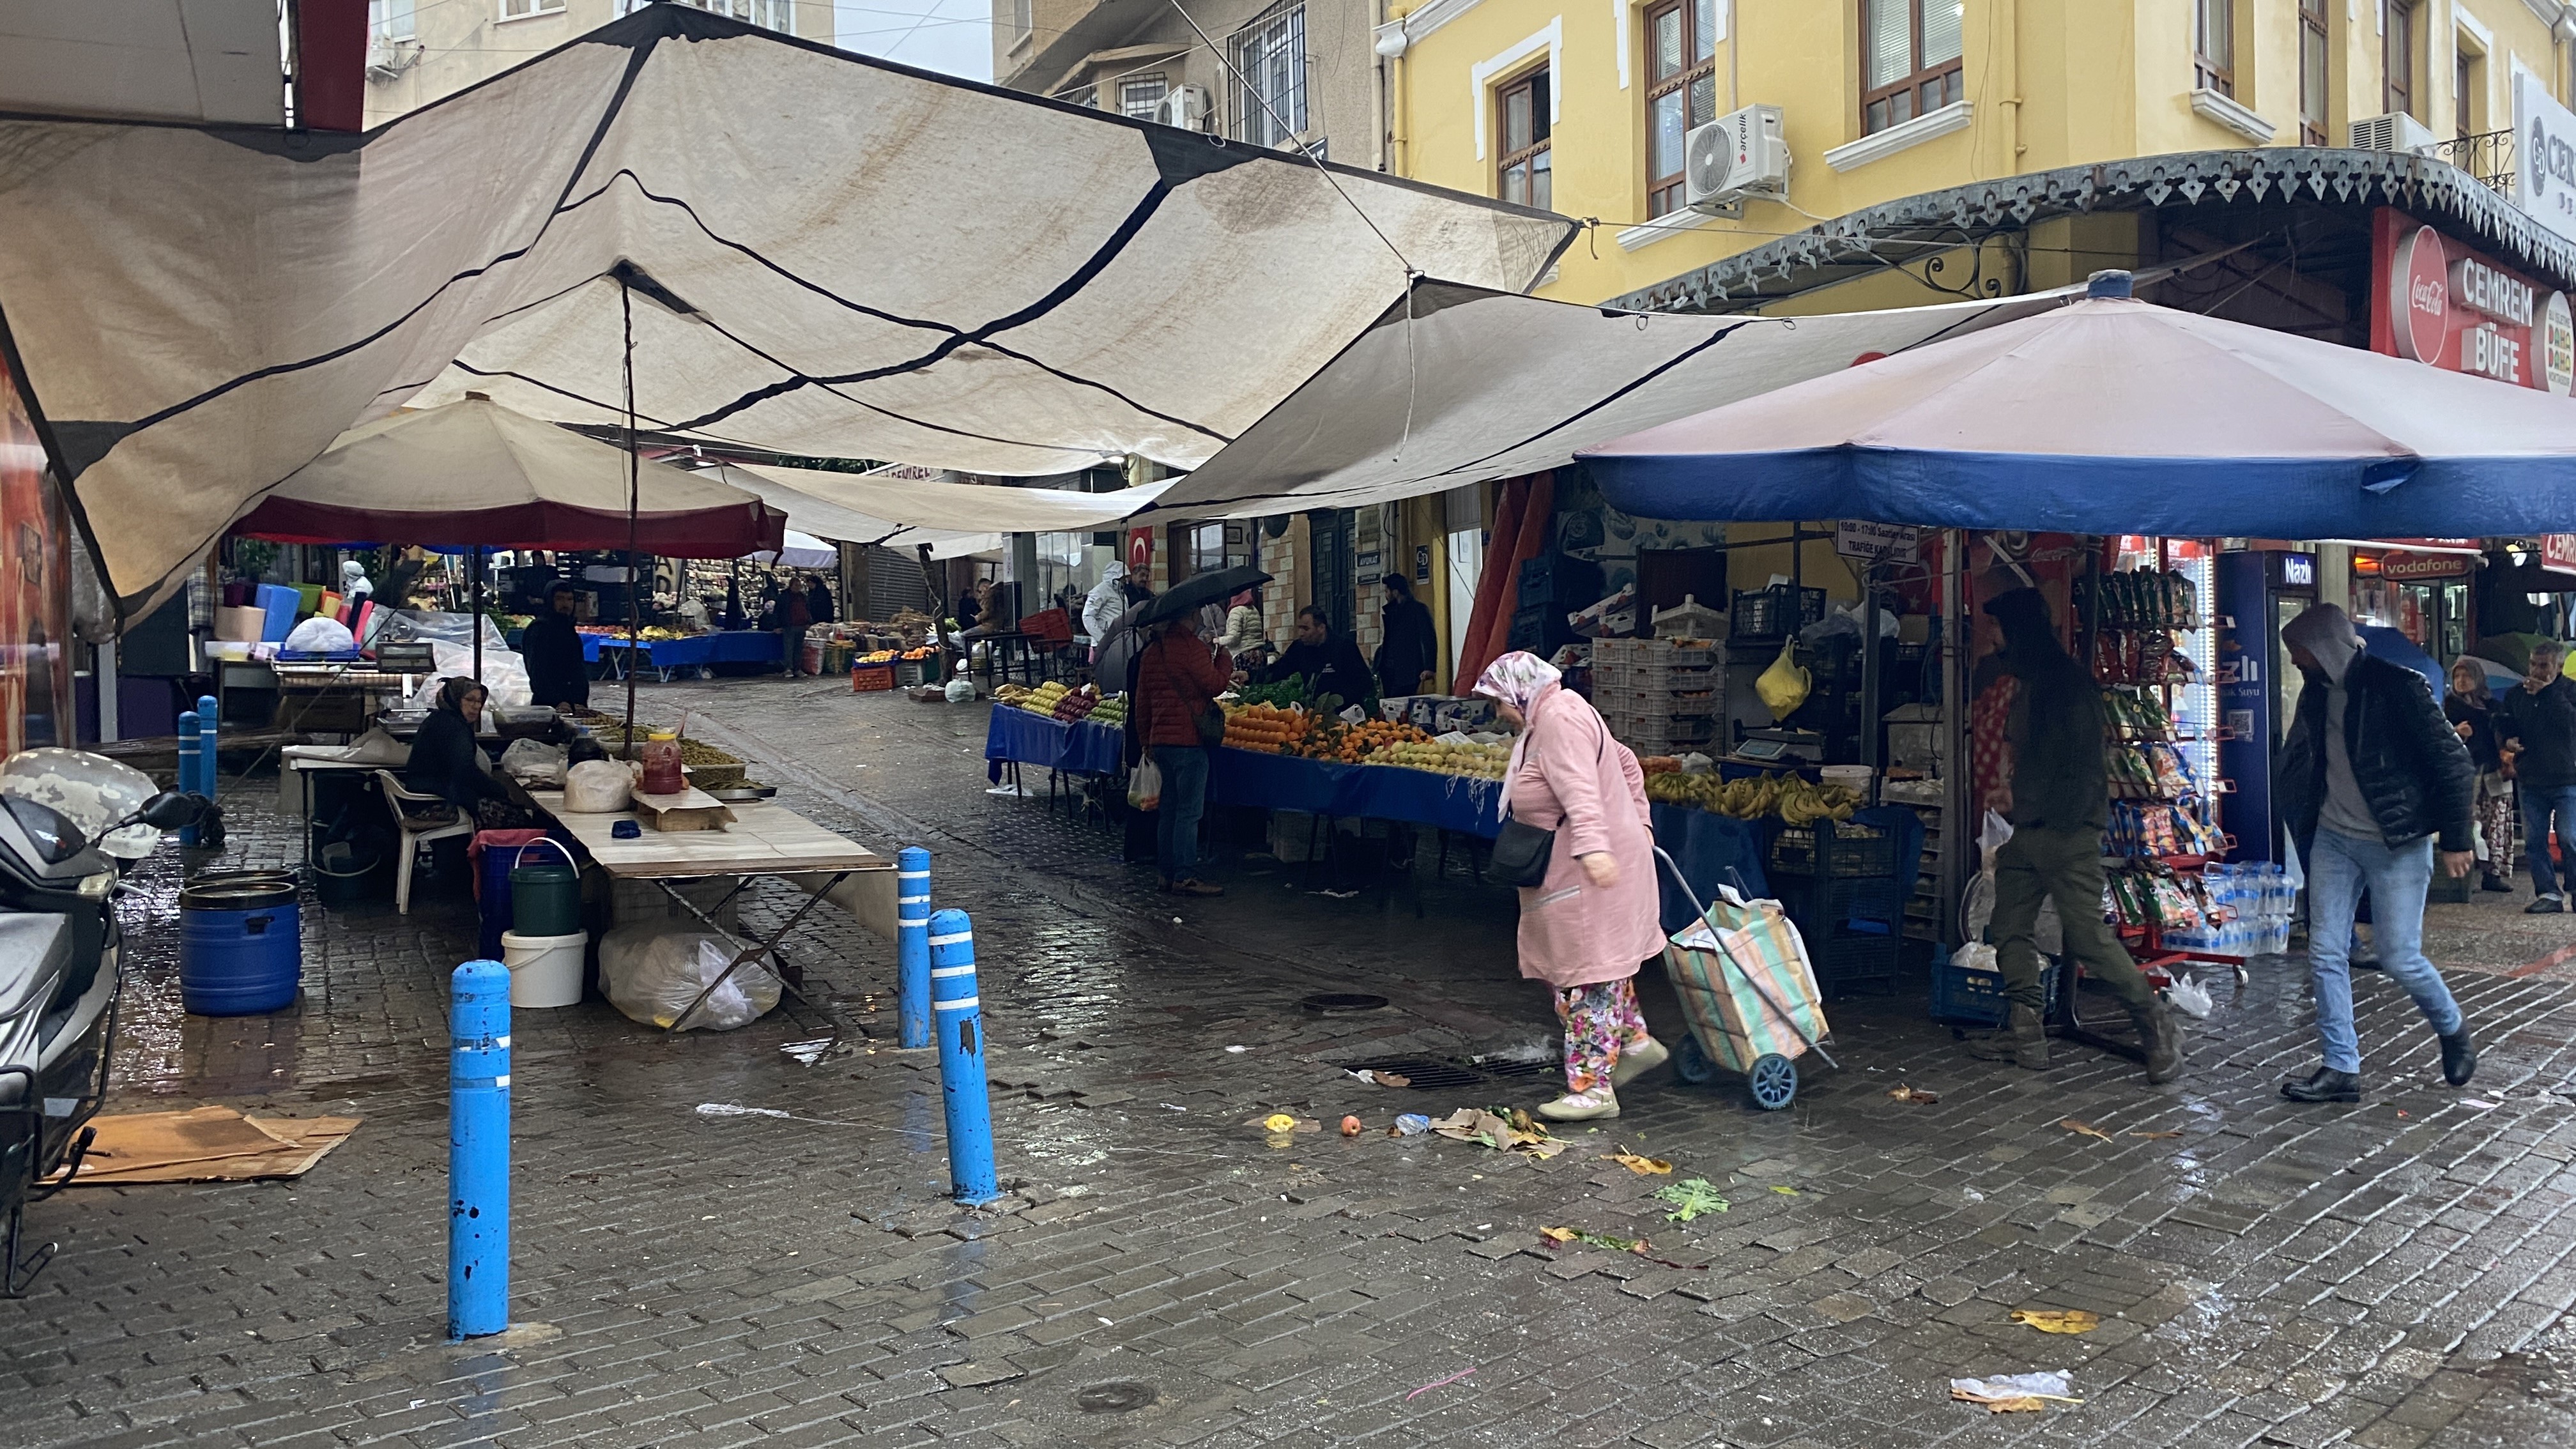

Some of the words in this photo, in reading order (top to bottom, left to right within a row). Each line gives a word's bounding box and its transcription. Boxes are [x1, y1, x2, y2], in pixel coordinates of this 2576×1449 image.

[1739, 114, 1747, 151] arçelik
[2547, 134, 2576, 188] CER
[2412, 275, 2444, 316] Coca-Cola
[2464, 257, 2533, 327] CEMREM
[2549, 324, 2571, 349] DAHA
[2476, 321, 2519, 383] BÜFE
[2549, 347, 2571, 374] DAHA
[1360, 555, 1378, 566] AVUKAT
[2547, 534, 2576, 564] CEMR
[2285, 558, 2312, 584] Nazlı
[2388, 559, 2462, 574] vodafone
[2222, 656, 2258, 682] zlı
